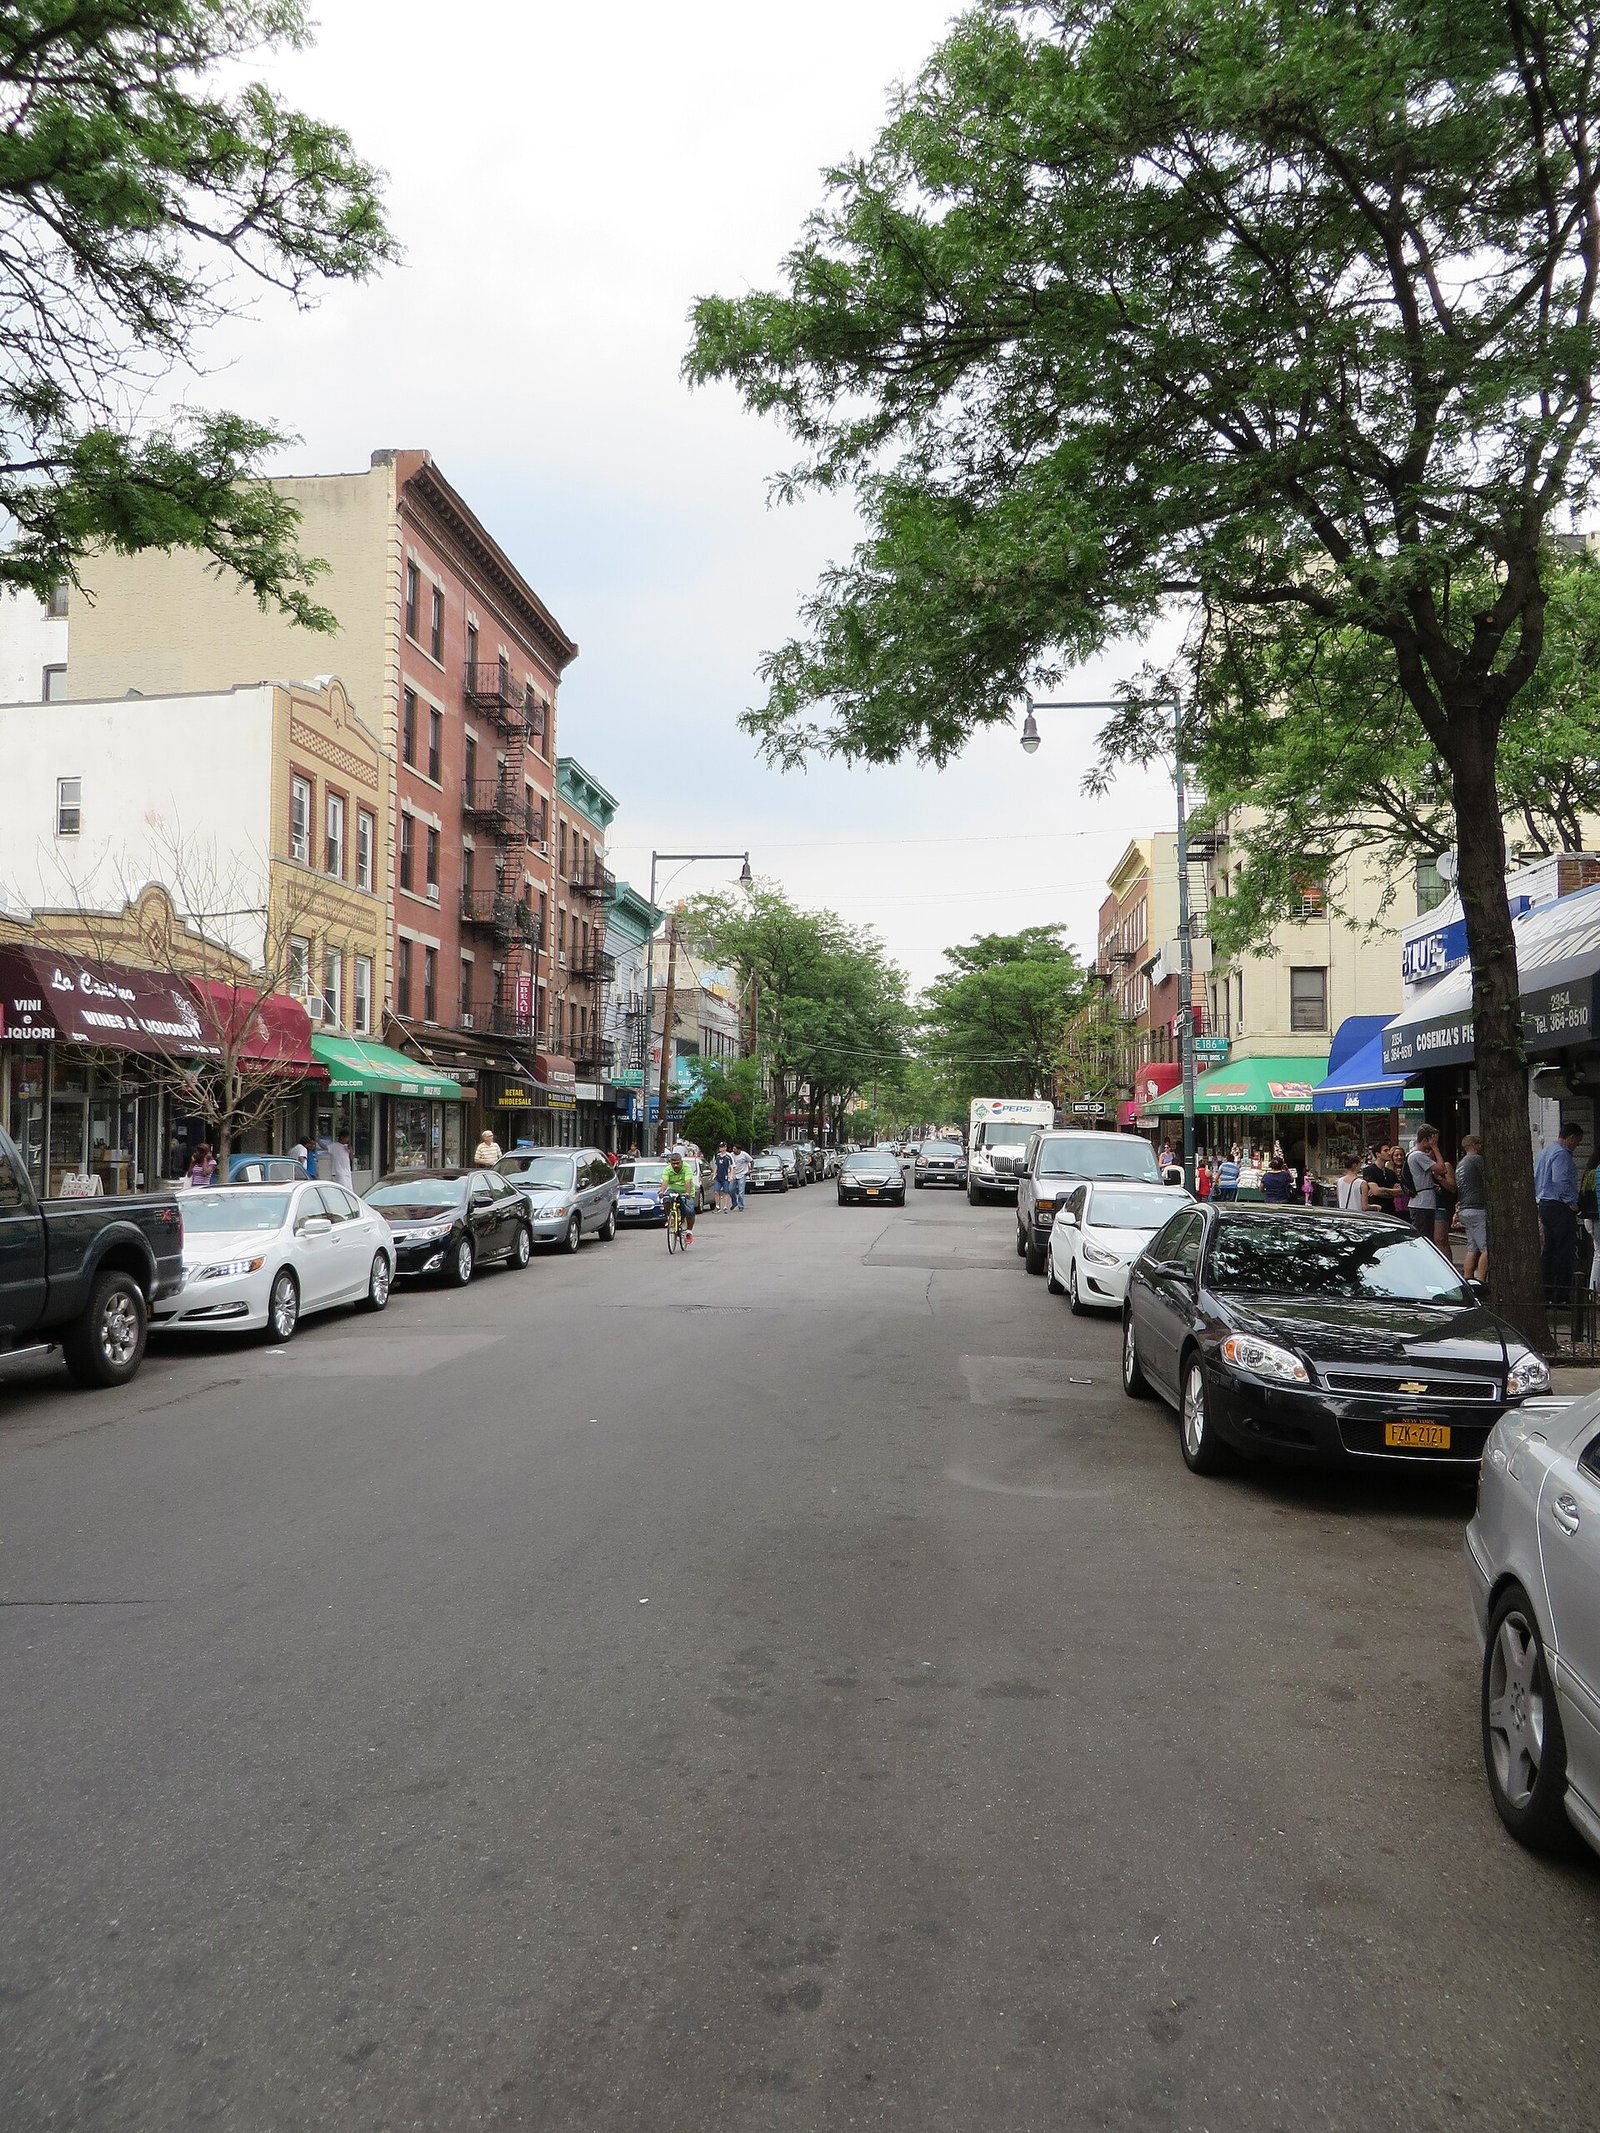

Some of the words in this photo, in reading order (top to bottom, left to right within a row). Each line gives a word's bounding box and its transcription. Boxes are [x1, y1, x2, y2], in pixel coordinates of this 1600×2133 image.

[1402, 934, 1444, 977] BLUE
[52, 968, 75, 992] La
[14, 999, 42, 1011] VINI
[23, 1015, 33, 1024] e
[81, 1010, 126, 1030] WINES
[139, 1019, 193, 1038] LIQUORS
[1549, 1006, 1588, 1031] 364-8510
[1416, 1027, 1459, 1051] COSENZA'S
[1462, 1023, 1475, 1044] FIS
[1195, 1040, 1201, 1049] E
[1202, 1040, 1217, 1049] 186
[504, 1089, 525, 1097] RETAIL
[498, 1097, 532, 1105] WHOLESALE
[1225, 1104, 1258, 1112] 733-9400
